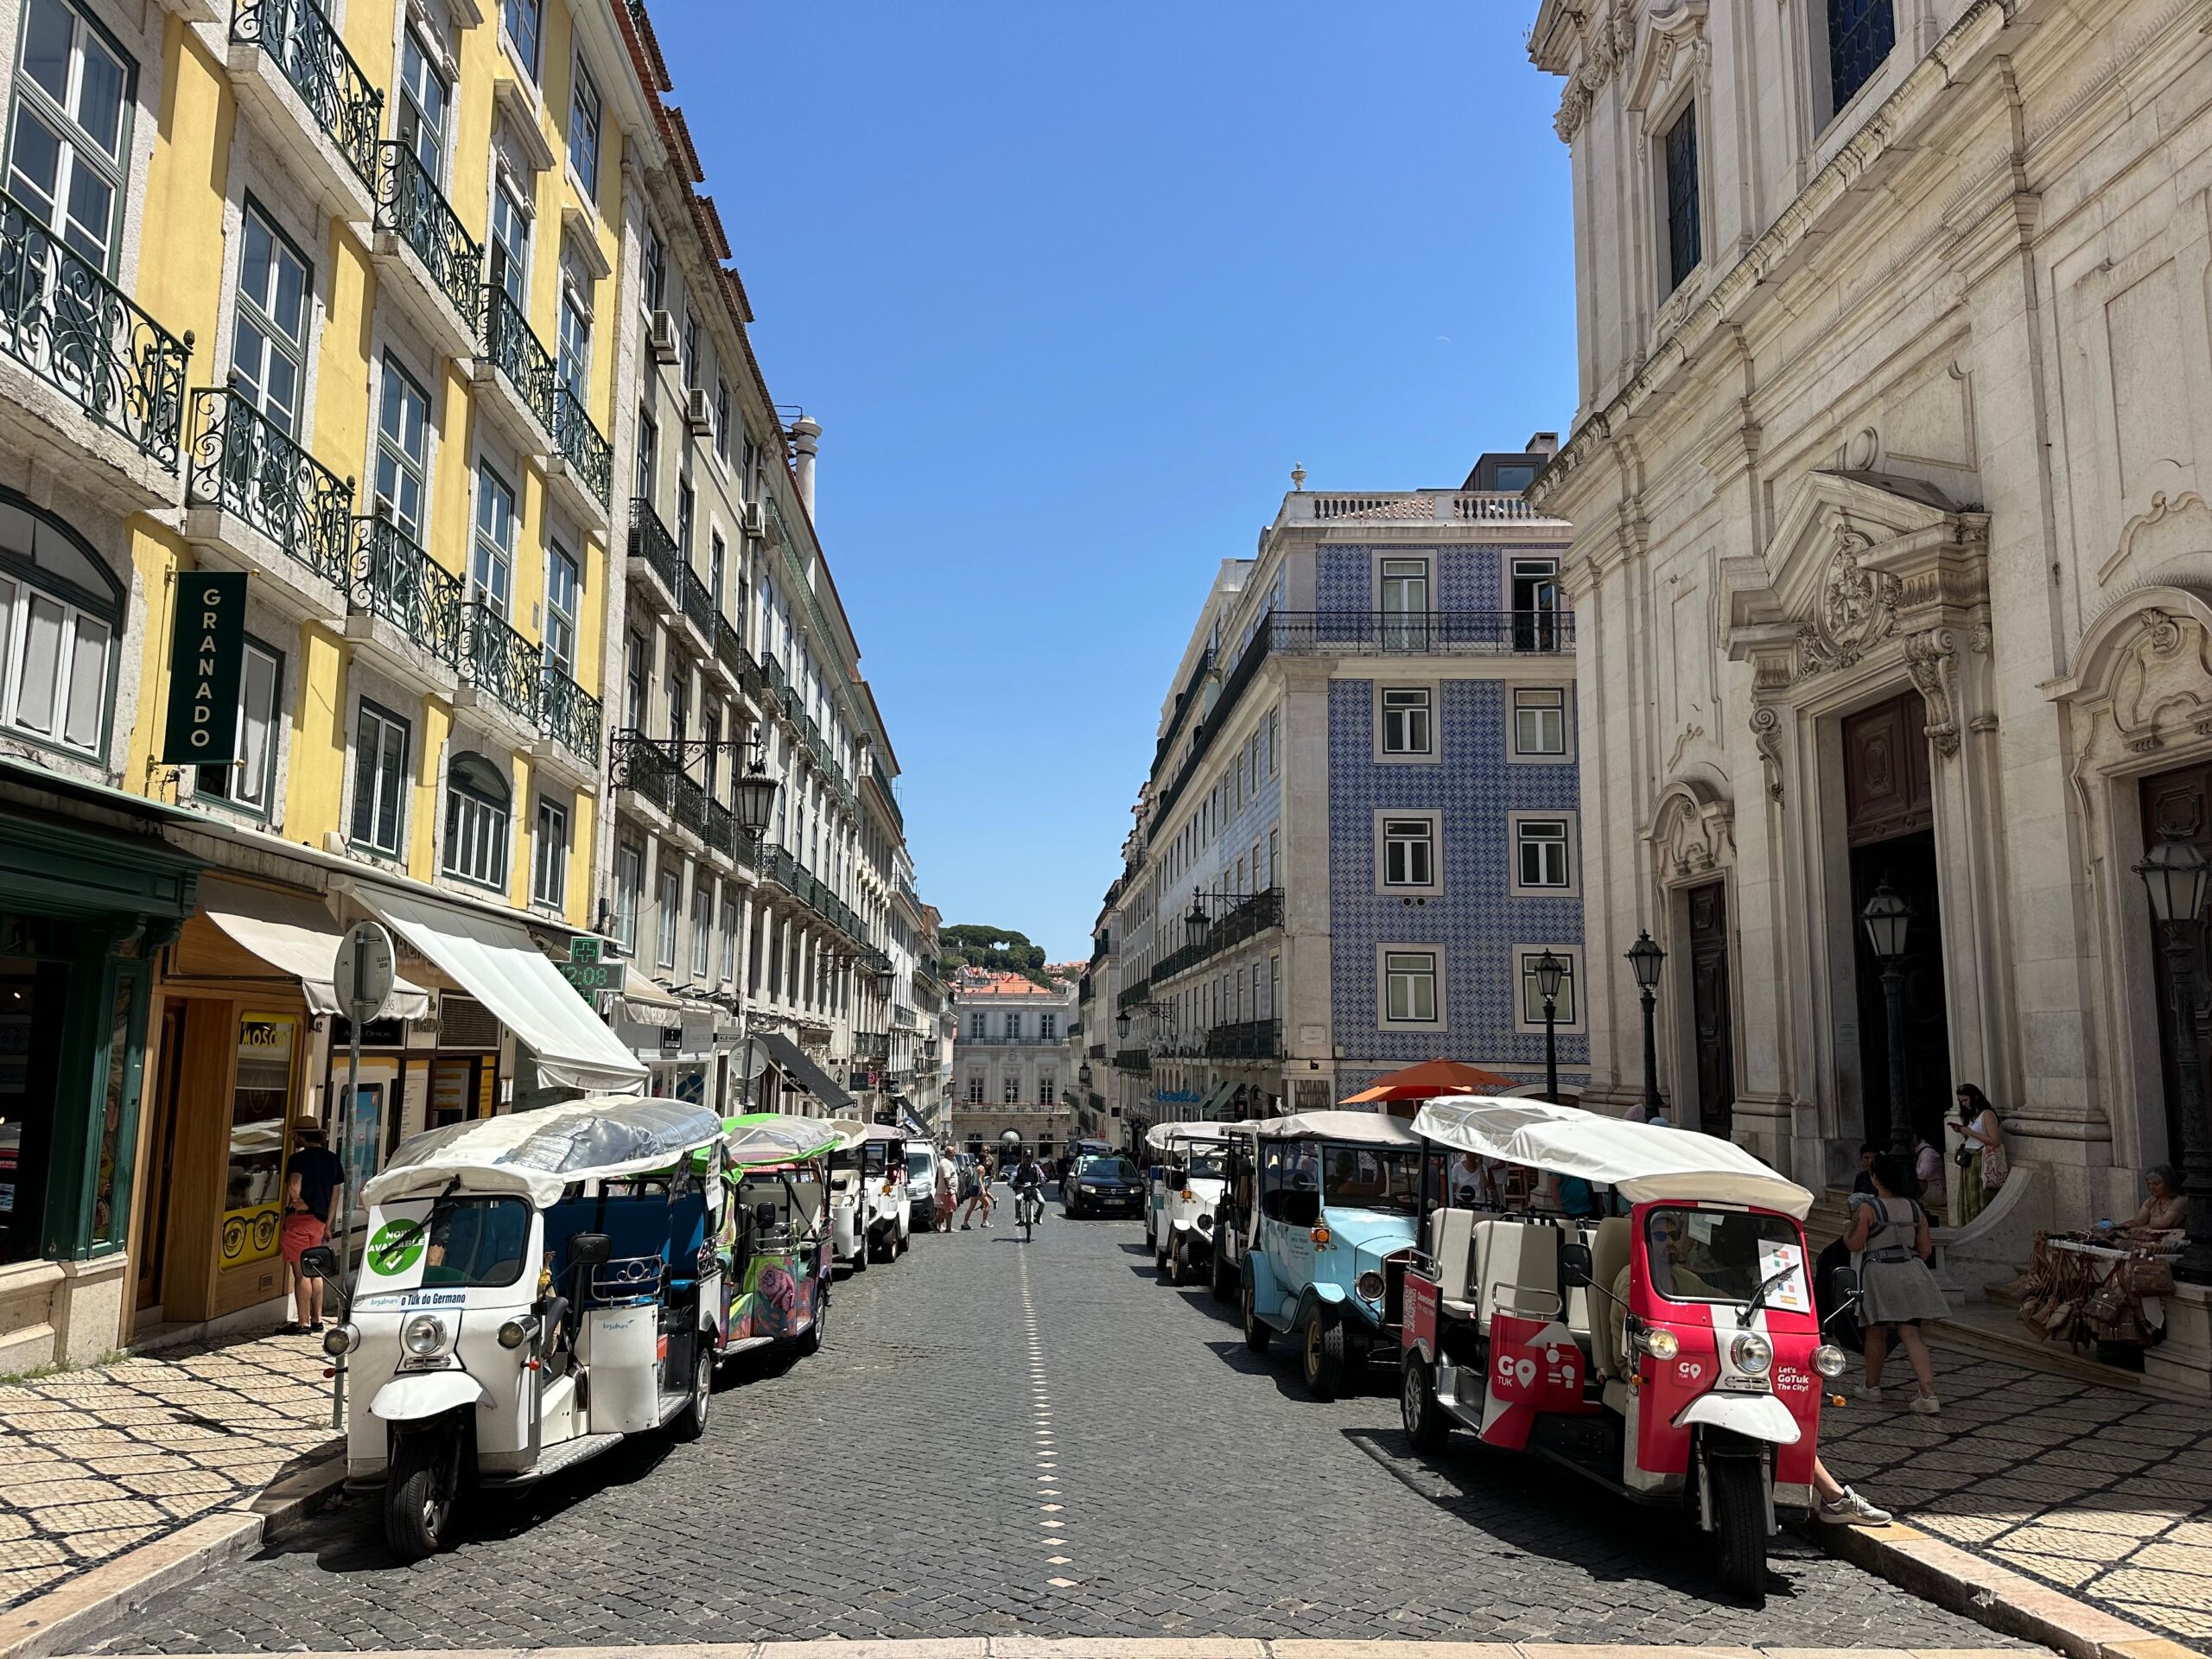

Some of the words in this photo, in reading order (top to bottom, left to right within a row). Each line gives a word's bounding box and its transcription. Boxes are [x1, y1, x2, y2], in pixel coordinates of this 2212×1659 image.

[190, 588, 221, 747] GRANADO
[367, 1238, 426, 1253] AVAABLE
[401, 1297, 406, 1306] o
[408, 1294, 420, 1306] Tuk
[422, 1294, 431, 1305] do
[433, 1293, 466, 1305] Germano
[1417, 1291, 1436, 1308] Download
[1497, 1376, 1512, 1387] TUK
[1777, 1374, 1809, 1384] GoTuk
[1792, 1383, 1809, 1392] City!
